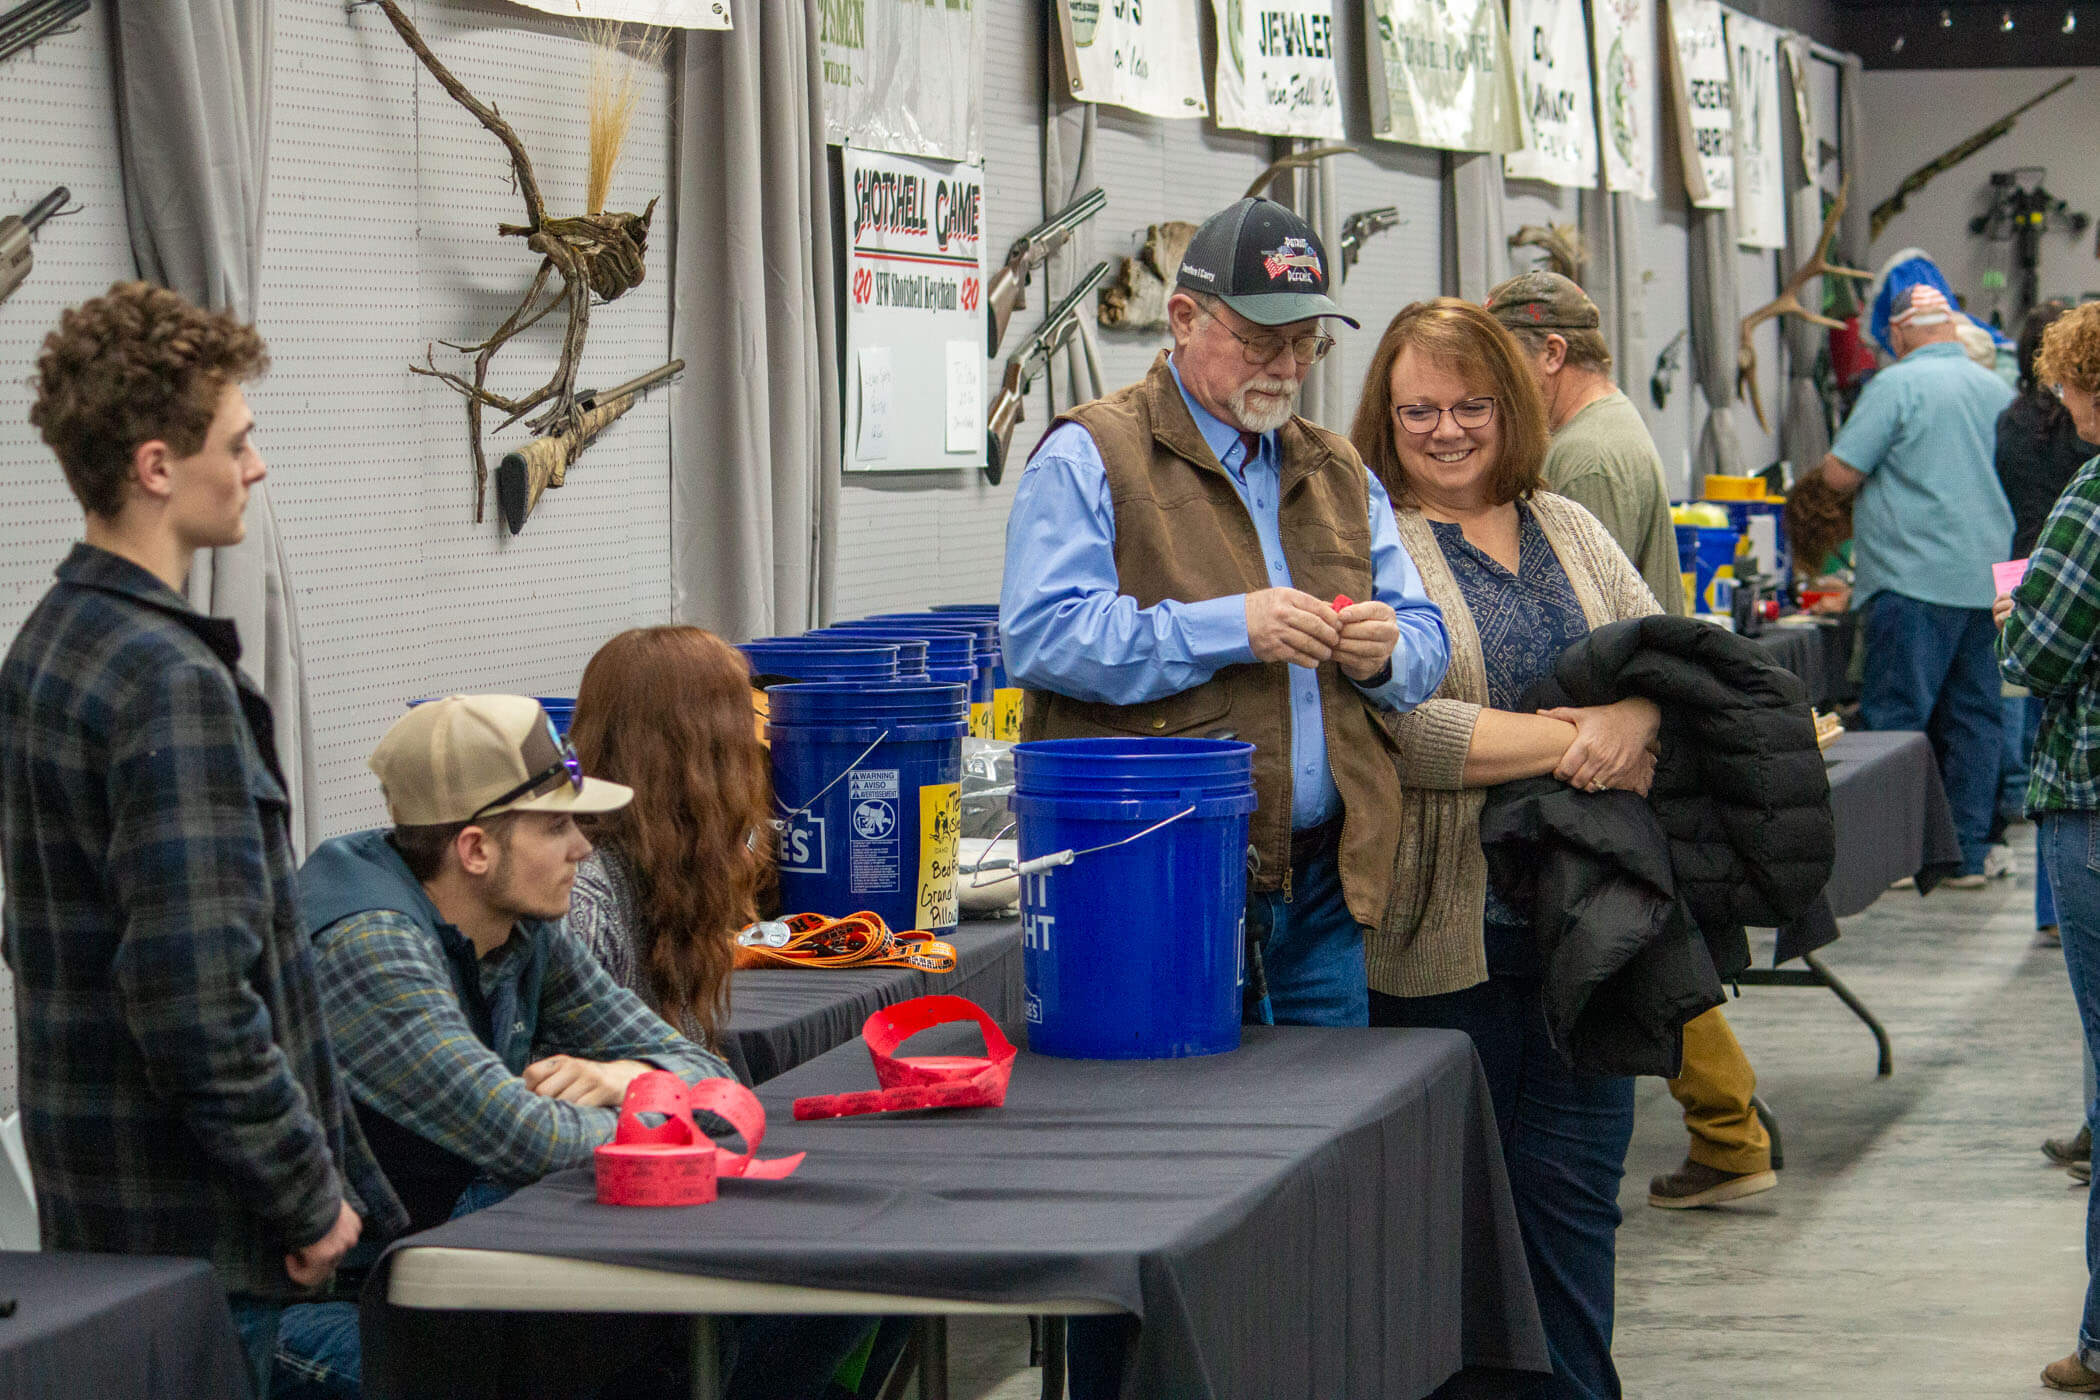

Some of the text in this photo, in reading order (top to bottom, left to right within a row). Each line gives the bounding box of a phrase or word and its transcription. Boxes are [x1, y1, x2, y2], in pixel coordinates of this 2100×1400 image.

[854, 166, 981, 251] SHOTSHELL GAME
[891, 274, 923, 309] Shotshell
[924, 276, 958, 315] Keychain
[859, 772, 895, 780] WARNING
[864, 781, 886, 789] AVISO
[932, 859, 951, 880] Bed
[920, 883, 952, 908] Grand
